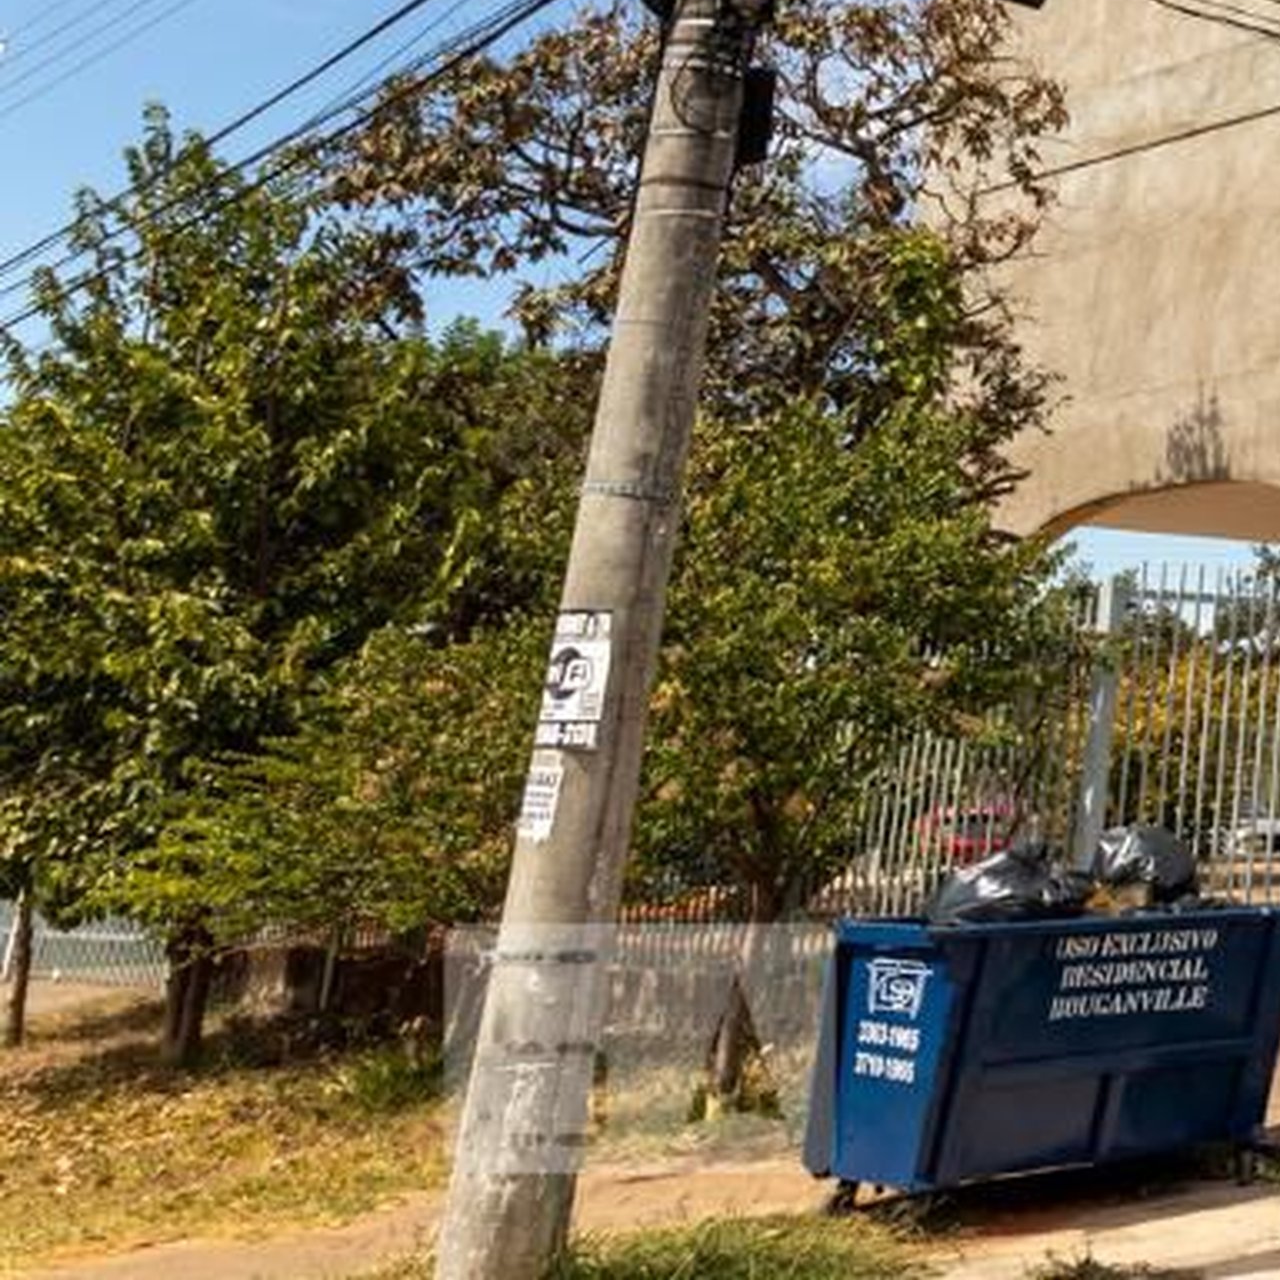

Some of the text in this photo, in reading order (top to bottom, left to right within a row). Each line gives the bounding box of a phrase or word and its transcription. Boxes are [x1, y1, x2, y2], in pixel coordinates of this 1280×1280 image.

[1056, 929, 1219, 959] USO EXCLUSIVO
[1060, 957, 1209, 991] RESIDENCIAL
